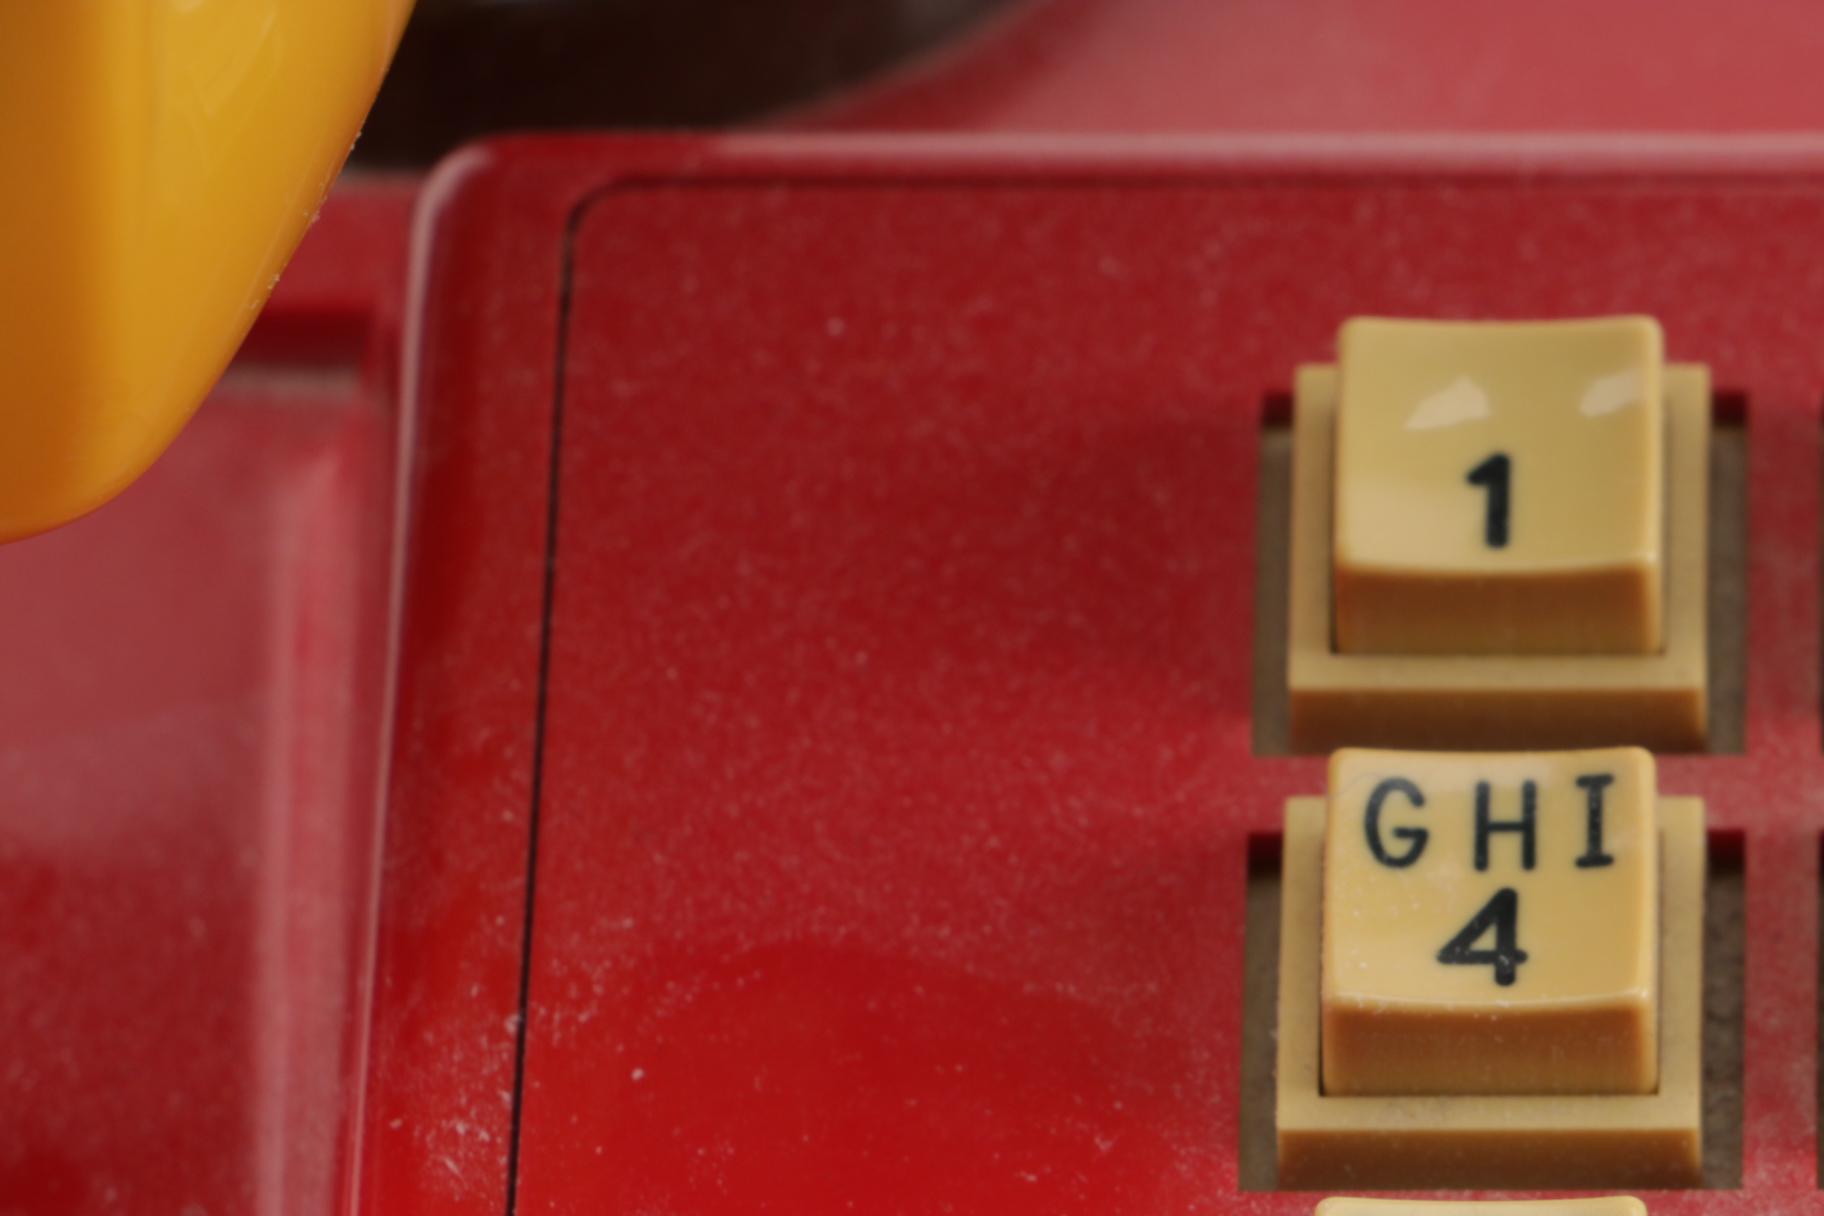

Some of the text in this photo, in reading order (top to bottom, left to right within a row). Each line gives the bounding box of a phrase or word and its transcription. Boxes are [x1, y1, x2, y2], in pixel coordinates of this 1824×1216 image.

[1462, 449, 1515, 552] 1
[1361, 770, 1617, 875] GHI
[1434, 884, 1531, 990] 4
